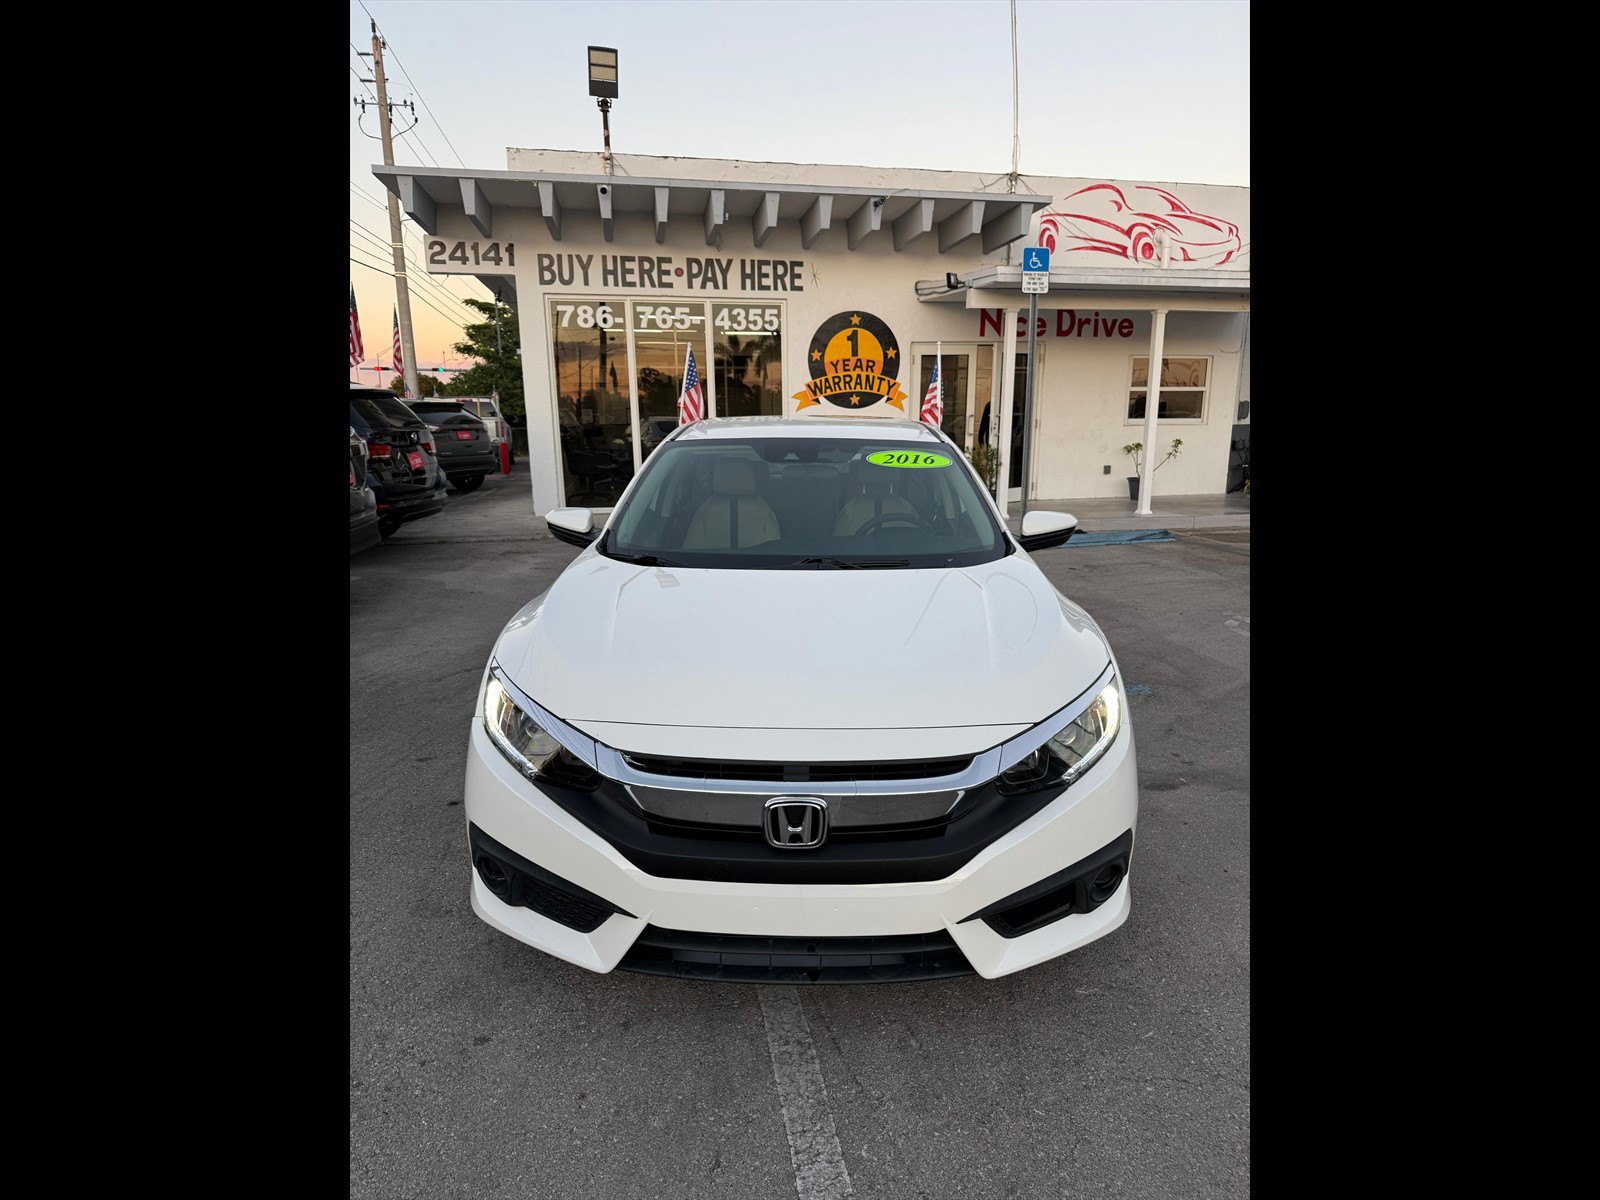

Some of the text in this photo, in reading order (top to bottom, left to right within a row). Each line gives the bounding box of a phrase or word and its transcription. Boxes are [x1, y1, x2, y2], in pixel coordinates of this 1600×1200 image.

[428, 240, 515, 267] 24141
[537, 253, 804, 292] BUY HERE PAY HERE
[556, 304, 625, 329] 786-
[714, 307, 780, 331] 4355
[1055, 309, 1134, 337] Drive
[846, 329, 859, 357] 1
[830, 358, 876, 374] YEAR
[806, 373, 896, 397] WARRANTY
[881, 453, 936, 467] 2016
